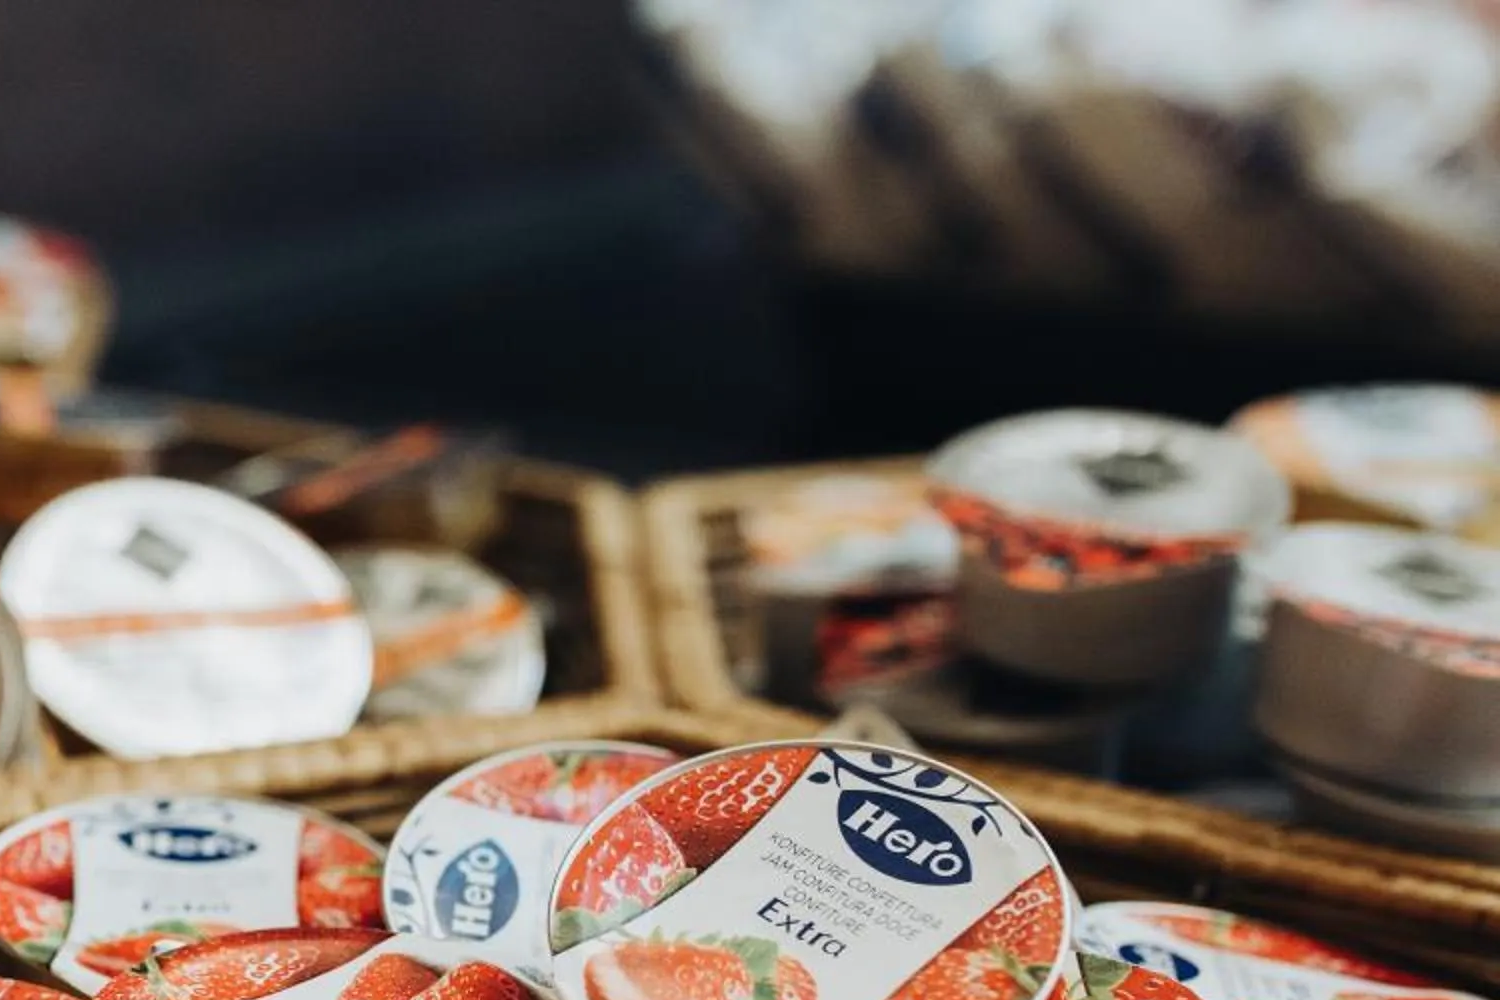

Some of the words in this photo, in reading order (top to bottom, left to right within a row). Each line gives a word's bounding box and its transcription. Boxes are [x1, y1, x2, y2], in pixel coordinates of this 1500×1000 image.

[842, 800, 963, 877] Hero
[451, 847, 499, 937] Hero
[760, 852, 795, 874] JAM
[793, 869, 874, 919] CONFITURA
[874, 914, 920, 941] DOCE
[770, 832, 849, 882] KONFITURE
[847, 876, 943, 930] CONFETTURA
[783, 886, 868, 936] CONFITURE
[756, 897, 847, 958] Extra
